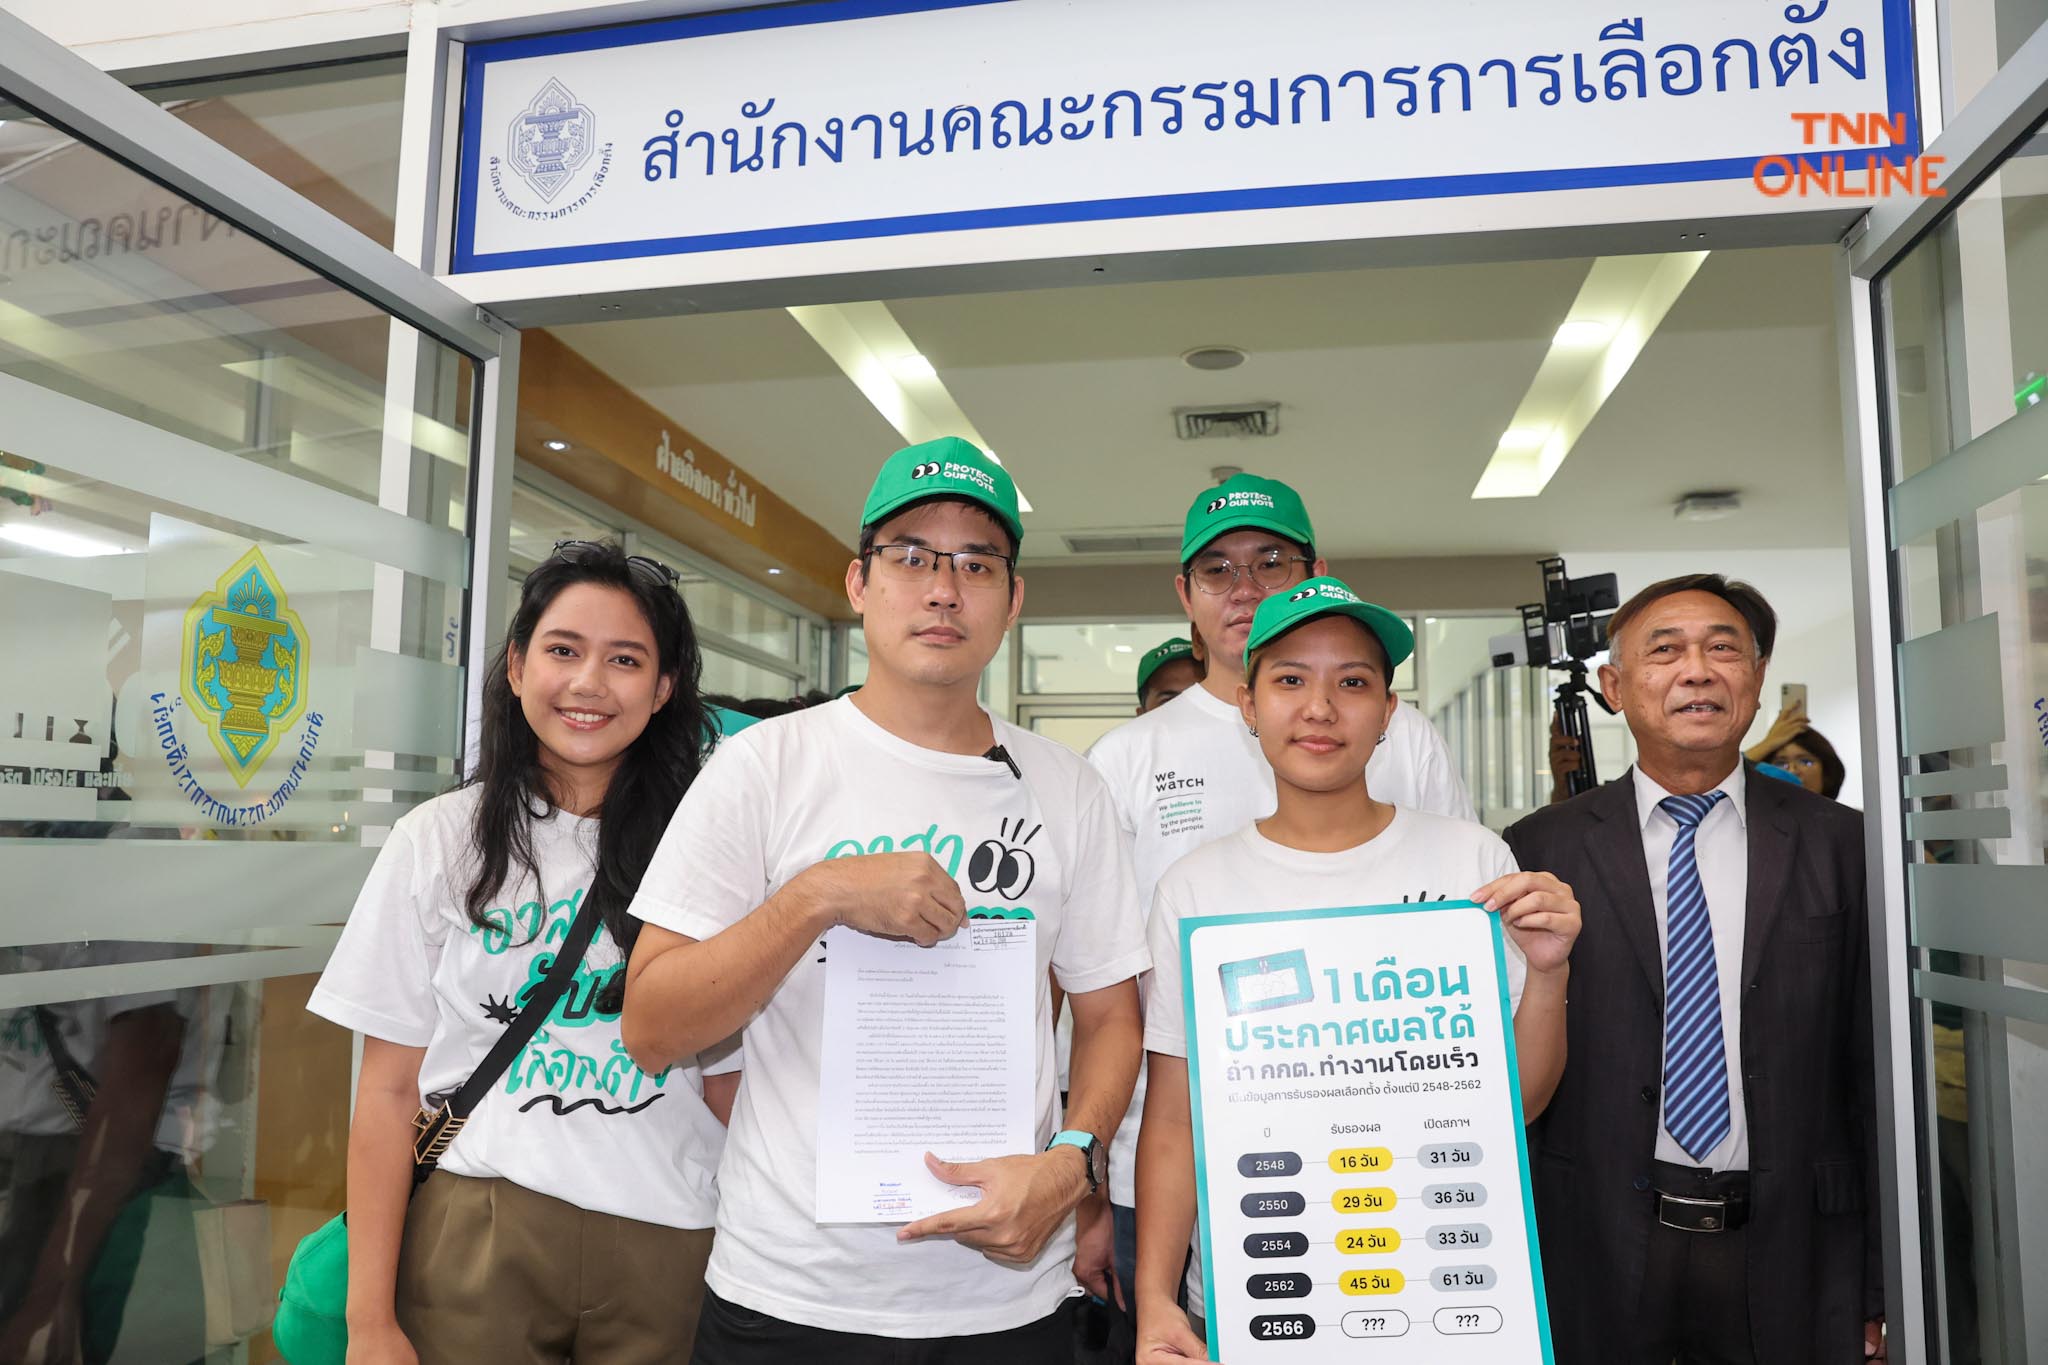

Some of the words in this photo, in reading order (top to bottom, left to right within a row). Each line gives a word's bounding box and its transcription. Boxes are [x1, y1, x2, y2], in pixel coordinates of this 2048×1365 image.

[943, 471, 967, 481] OUR
[968, 474, 995, 494] VOTE
[944, 461, 995, 485] PROTECT
[1228, 491, 1273, 502] PROTECT
[1228, 500, 1249, 508] OUR
[1249, 499, 1275, 509] VOTE
[1165, 808, 1202, 819] democracy
[1169, 800, 1194, 809] believe
[1323, 968, 1341, 1004] 1
[1353, 956, 1470, 1003] เดือน
[1225, 1003, 1476, 1052] ประกาศผลได้
[1227, 1059, 1255, 1081] ถ้า
[1261, 1062, 1315, 1080] กกต.
[1319, 1046, 1479, 1077] ทำงานโดยเร็ว
[1383, 1080, 1420, 1096] ตั้งแต่ปี
[1422, 1079, 1482, 1093] 2548-2562
[1330, 1122, 1382, 1135] รับรองผล
[1423, 1117, 1471, 1130] เปิดสภาฯ
[1255, 1159, 1286, 1172] 2548
[1340, 1156, 1357, 1168] 16
[1360, 1152, 1379, 1168] วัน
[1430, 1151, 1446, 1164] 31
[1451, 1149, 1471, 1163] วัน
[1258, 1199, 1289, 1211] 2550
[1343, 1196, 1360, 1208] 29
[1363, 1192, 1383, 1208] วัน
[1434, 1190, 1452, 1205] 36
[1456, 1189, 1475, 1204] วัน
[1261, 1239, 1292, 1251] 2554
[1346, 1236, 1364, 1249] 24
[1367, 1233, 1387, 1248] วัน
[1438, 1232, 1457, 1245] 33
[1460, 1229, 1480, 1244] วัน
[1264, 1280, 1295, 1292] 2562
[1350, 1277, 1368, 1290] 45
[1371, 1274, 1391, 1289] วัน
[1443, 1272, 1460, 1286] 61
[1464, 1270, 1484, 1285] วัน
[1261, 1320, 1305, 1337] 2566
[1361, 1317, 1386, 1331] ???
[1455, 1314, 1480, 1327] ???
